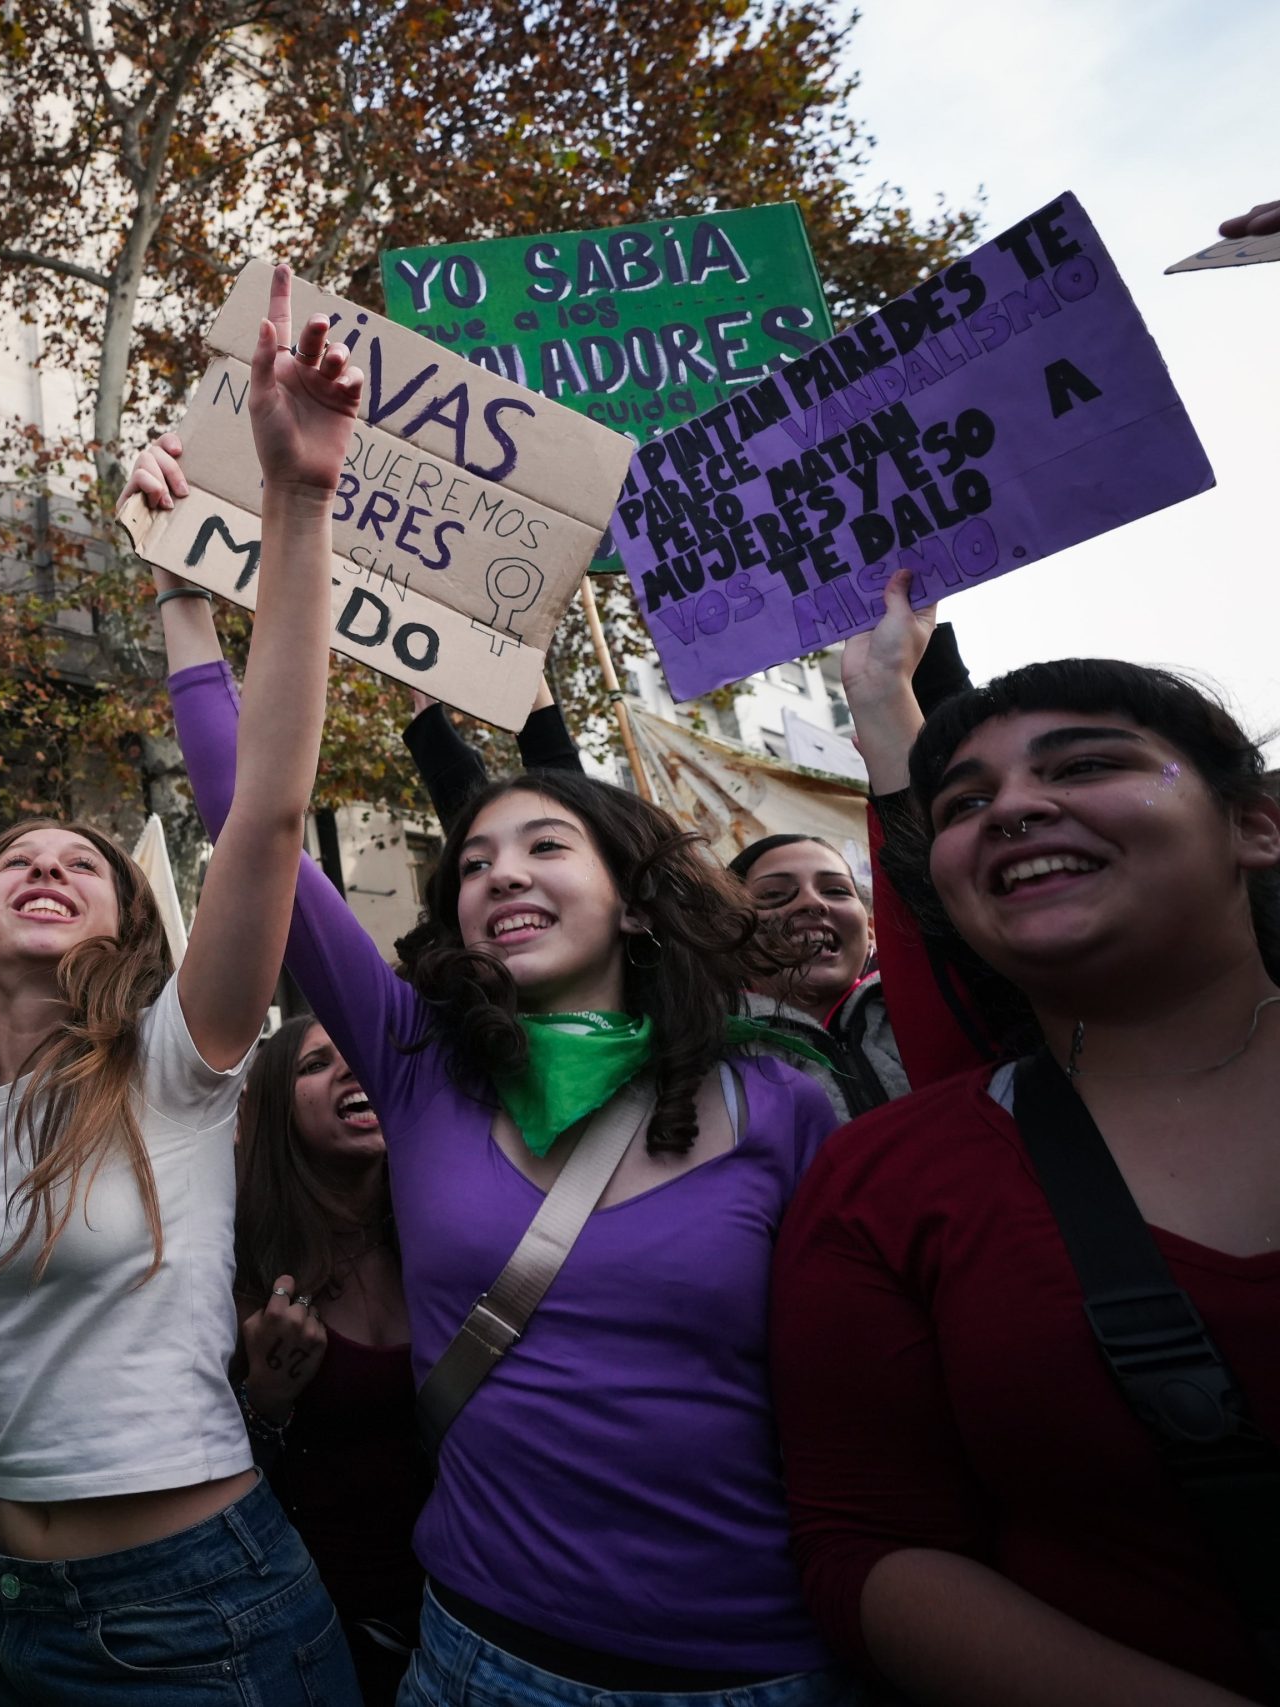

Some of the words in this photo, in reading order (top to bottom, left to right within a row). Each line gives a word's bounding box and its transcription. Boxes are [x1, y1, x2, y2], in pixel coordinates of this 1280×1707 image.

[395, 253, 487, 313] YO
[558, 297, 620, 329] los
[637, 377, 791, 488] PINTAN
[781, 261, 986, 410] PAREDES
[995, 201, 1082, 281] TE
[616, 442, 761, 540] PARECE
[781, 254, 1099, 450] VANDALISMO
[260, 472, 465, 571] BRES
[641, 485, 846, 613] MUJERES
[847, 457, 879, 513] Y
[890, 408, 996, 492] ESO
[1043, 358, 1103, 419] A
[646, 493, 744, 564] PERO
[766, 401, 920, 507] MATAN
[183, 513, 440, 672] MDO
[655, 572, 765, 646] VOS
[766, 531, 852, 597] TE
